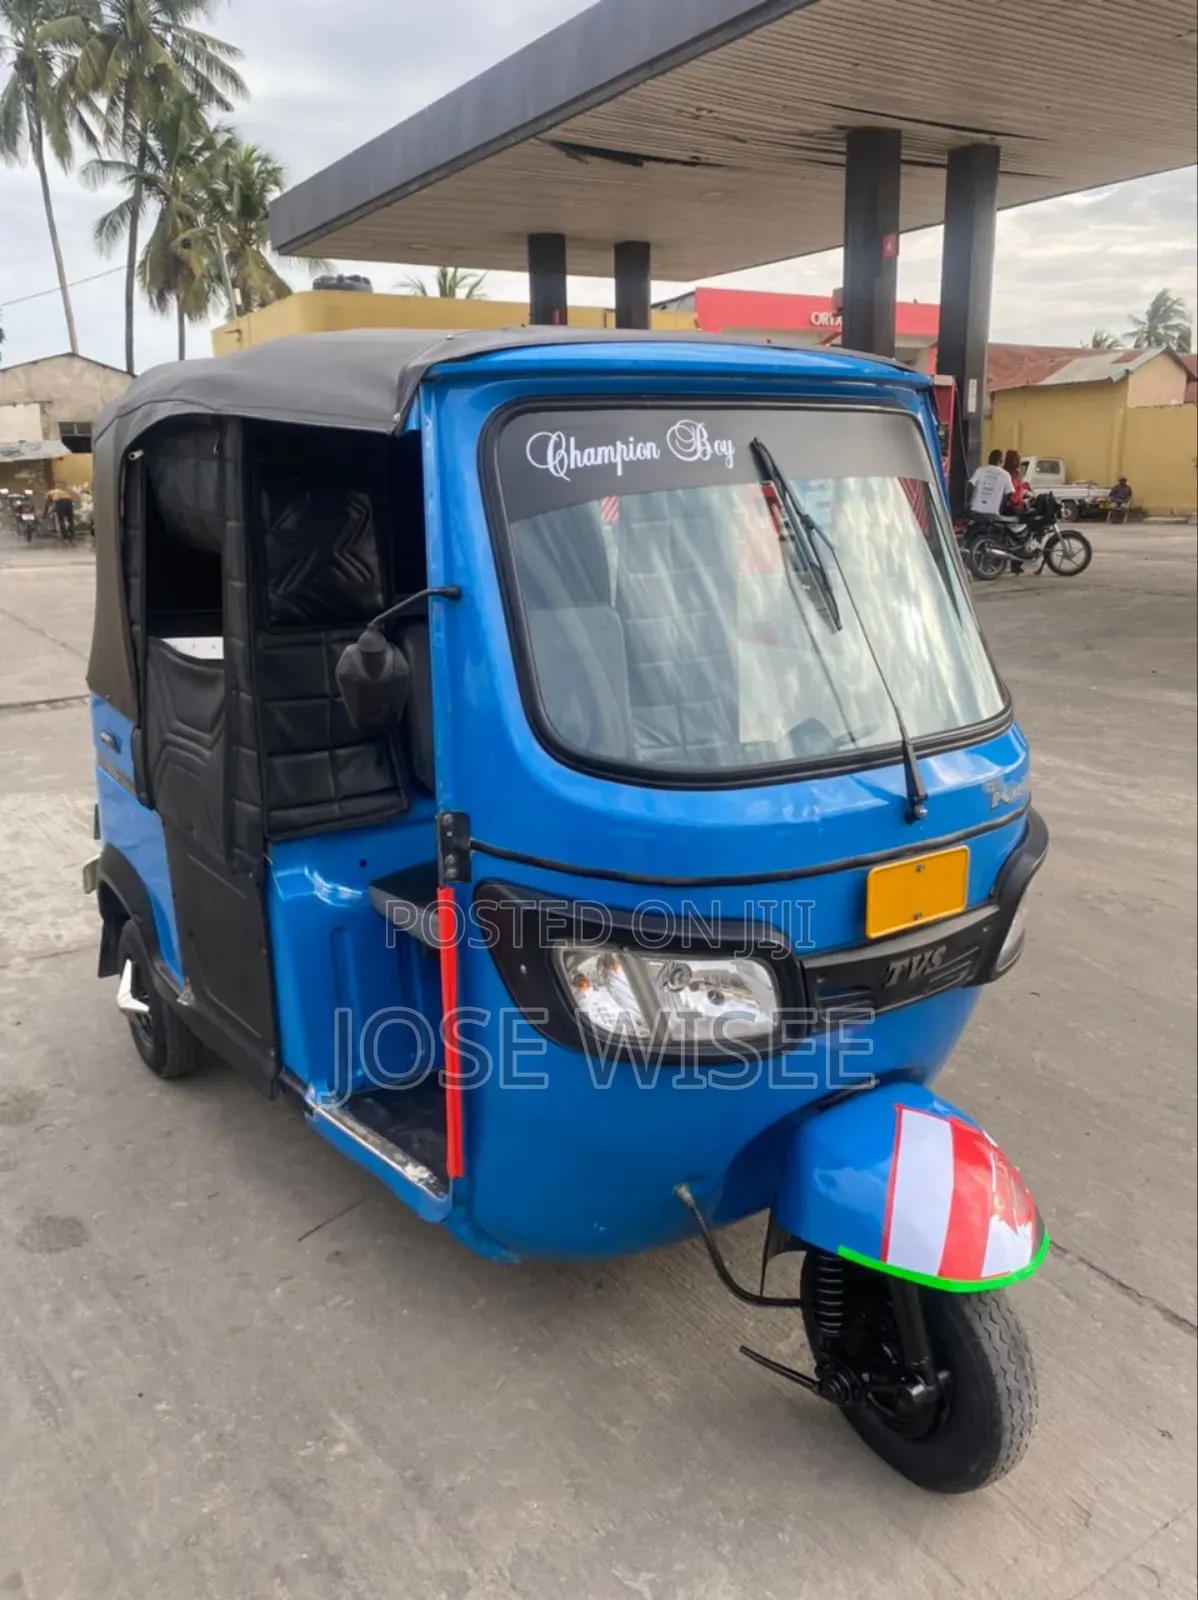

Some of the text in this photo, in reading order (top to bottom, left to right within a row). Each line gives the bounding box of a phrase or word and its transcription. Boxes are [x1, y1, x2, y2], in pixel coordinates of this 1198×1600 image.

[526, 419, 735, 482] Champion Boy
[884, 945, 947, 988] TVS
